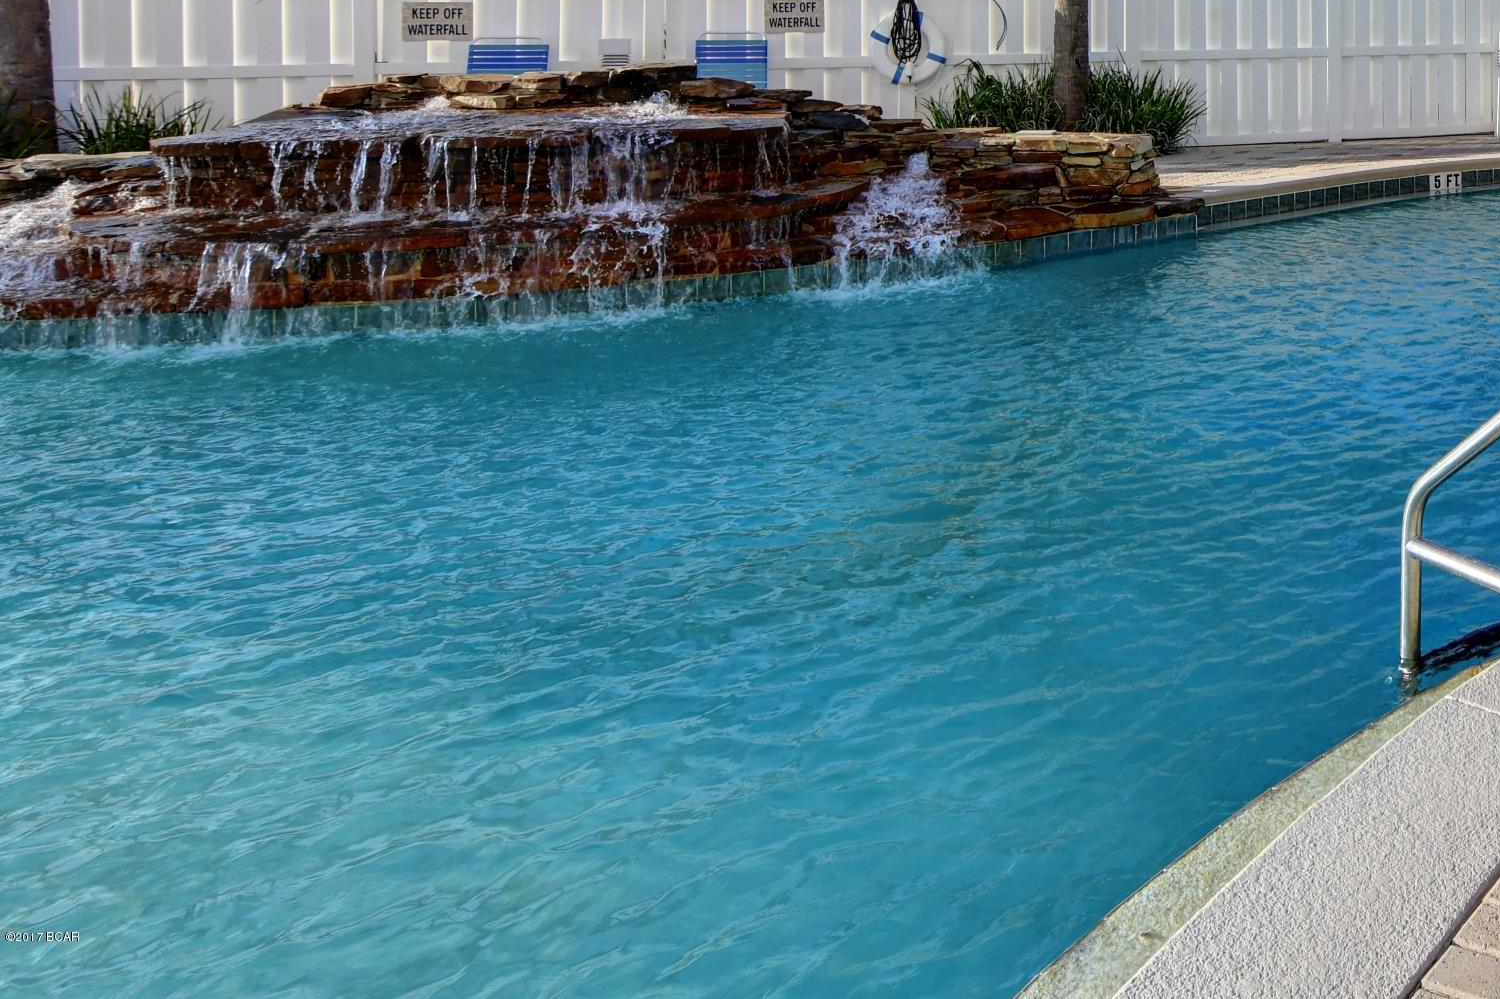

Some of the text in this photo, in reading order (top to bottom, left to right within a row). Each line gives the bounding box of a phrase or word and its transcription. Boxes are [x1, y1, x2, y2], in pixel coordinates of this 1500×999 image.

[412, 7, 464, 19] KEEP OFF
[772, 1, 817, 13] KEEP OFF
[769, 17, 821, 28] WATERFALL
[407, 23, 469, 36] WATERFALL
[1434, 175, 1441, 189] 5
